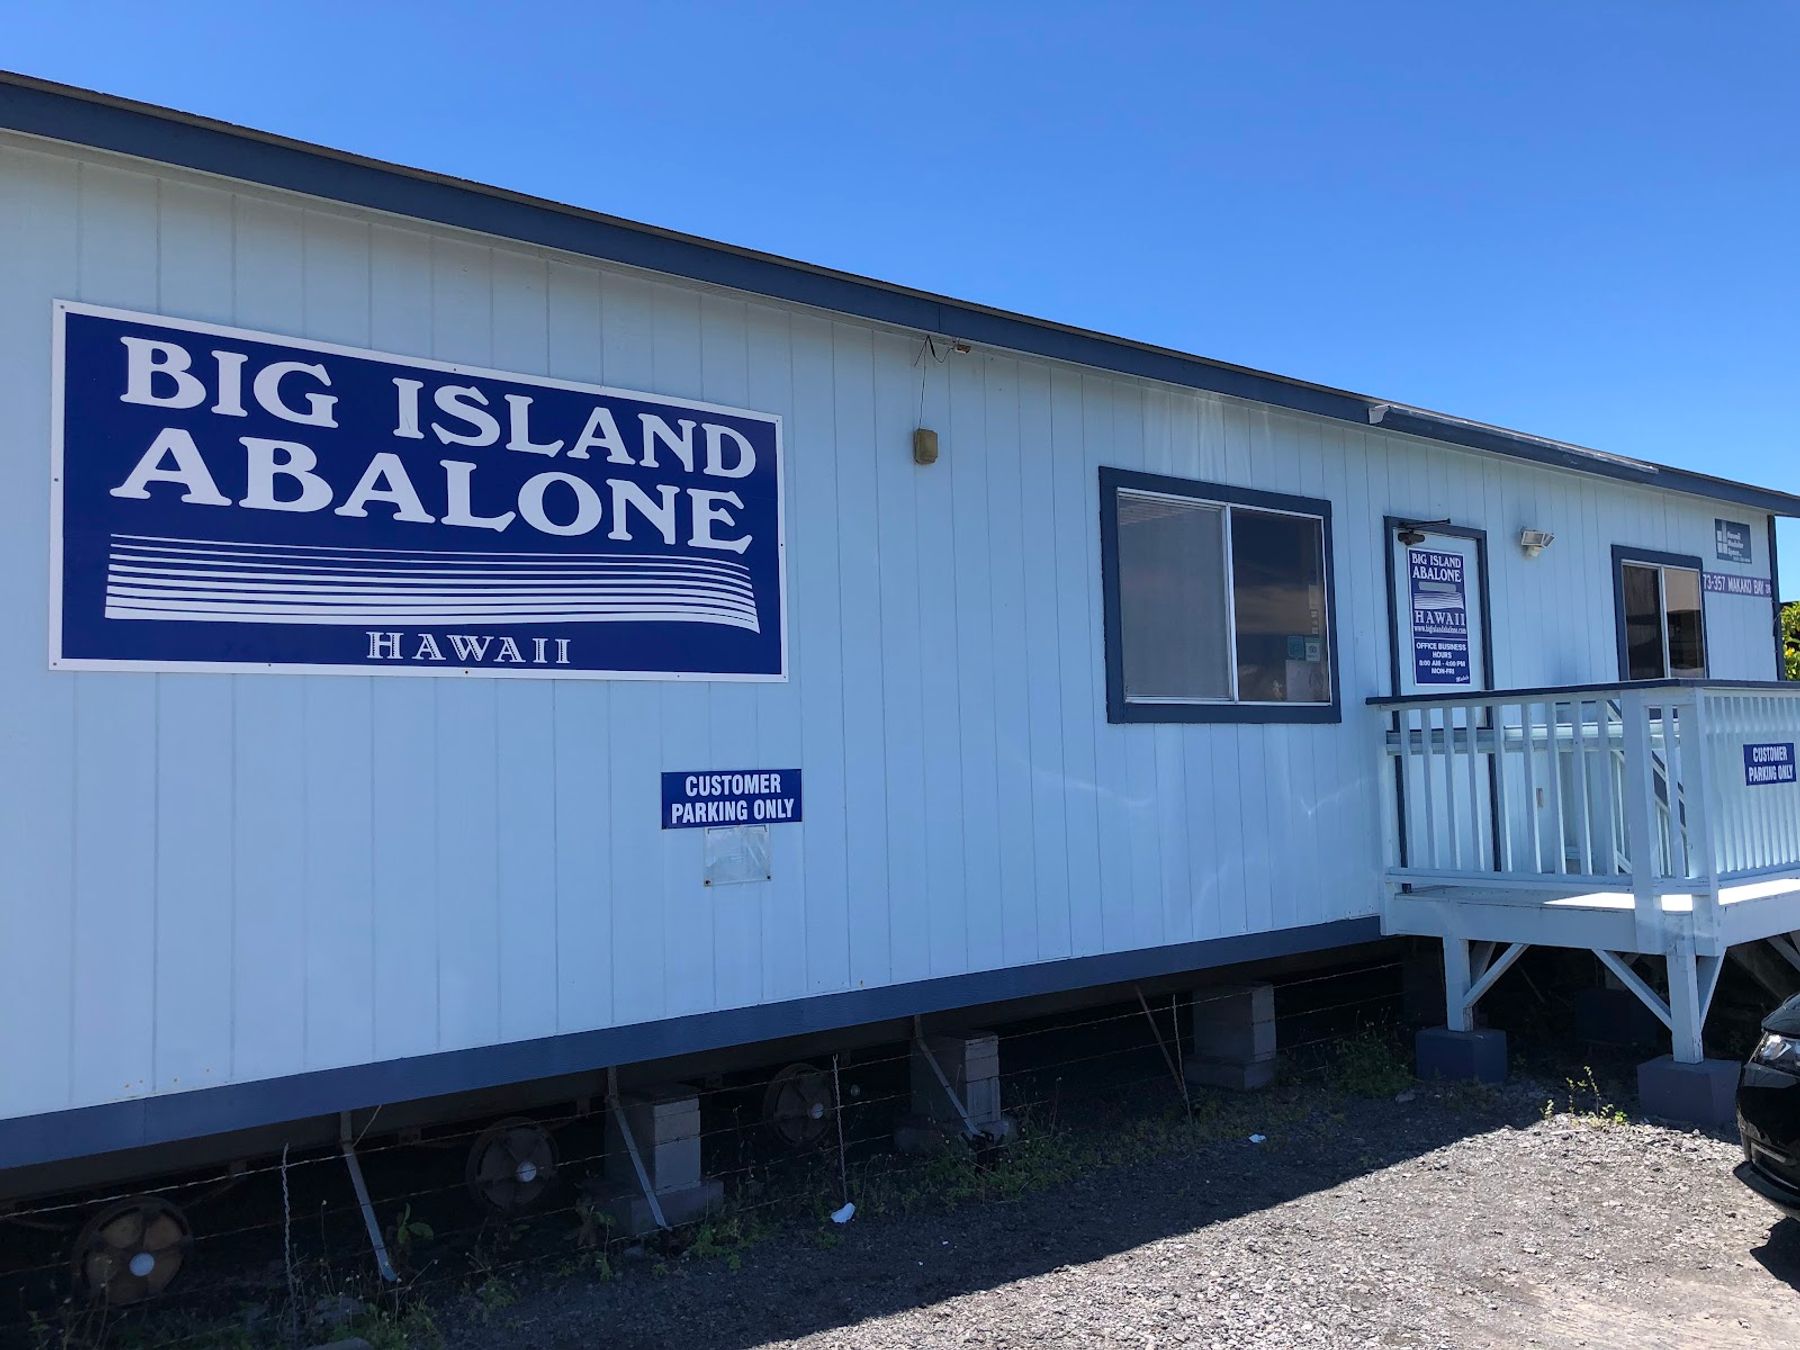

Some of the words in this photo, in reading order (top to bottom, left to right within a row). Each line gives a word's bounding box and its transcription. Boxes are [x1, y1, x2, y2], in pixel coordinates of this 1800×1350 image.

[119, 336, 339, 428] BIG
[392, 377, 757, 479] ISLAND
[109, 427, 753, 554] ABALONE
[1412, 553, 1427, 565] BIG
[1430, 555, 1461, 567] ISLAND
[1412, 566, 1461, 582] ABALONE
[1703, 574, 1725, 590] 73-357
[1414, 610, 1465, 626] HAWAII
[365, 630, 571, 665] HAWAII
[1416, 642, 1437, 650] OFFICE
[1438, 643, 1466, 651] BUSINESS
[1433, 651, 1452, 659] HOURS
[1753, 746, 1787, 762] CUSTOMER
[1749, 766, 1777, 782] PARKING
[1778, 764, 1793, 779] ONLY
[685, 773, 782, 797] CUSTOMER
[671, 799, 748, 824] PARKING
[753, 798, 795, 820] ONLY
